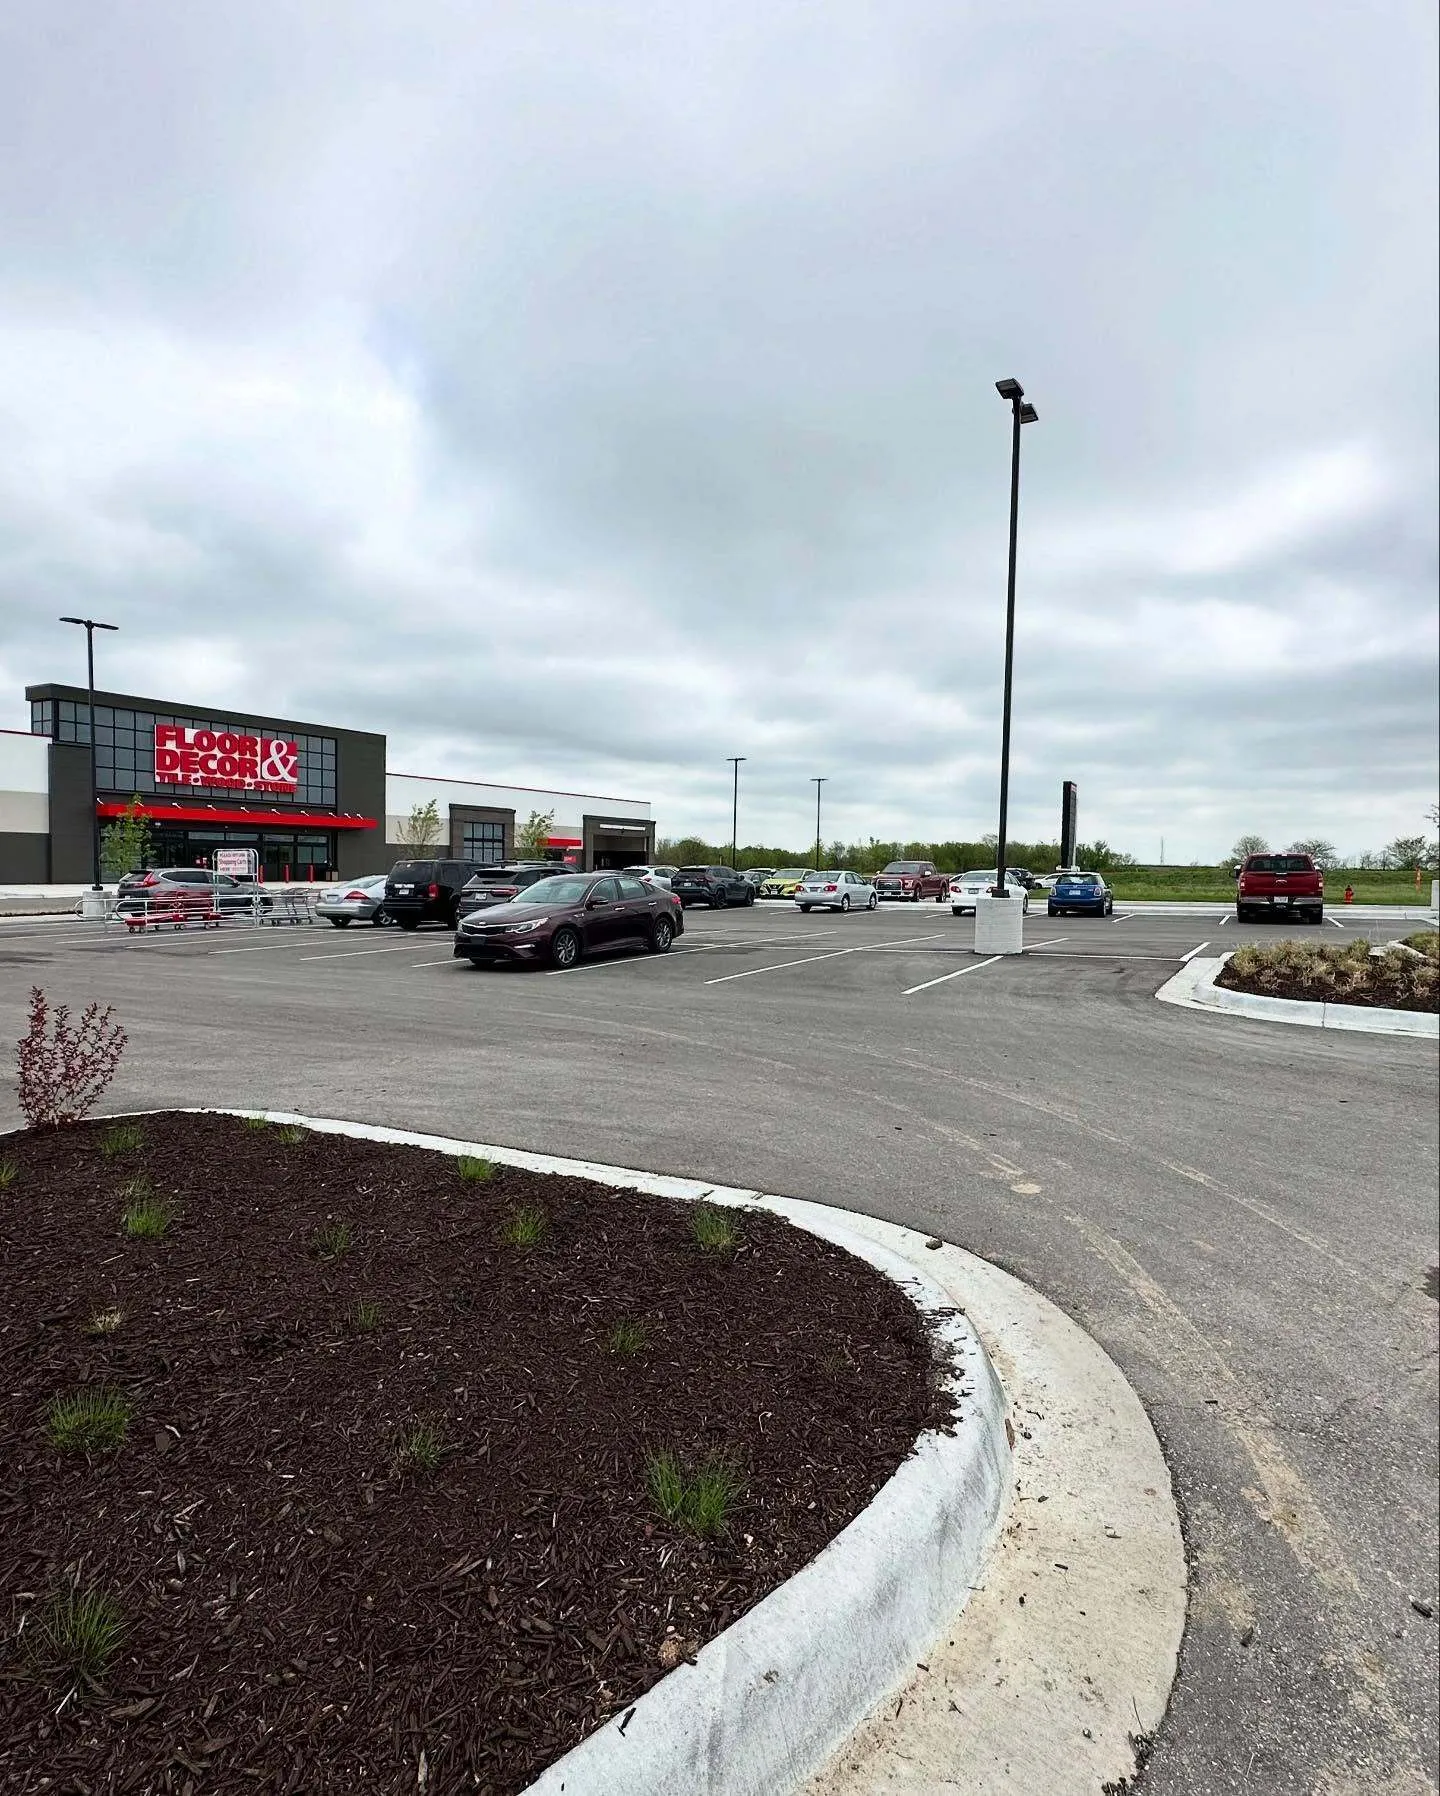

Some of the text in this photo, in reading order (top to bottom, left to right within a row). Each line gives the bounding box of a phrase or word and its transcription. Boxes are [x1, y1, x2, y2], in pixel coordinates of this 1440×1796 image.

[156, 724, 258, 757] FLOOR
[156, 748, 258, 779] DECOR
[261, 739, 298, 781] &
